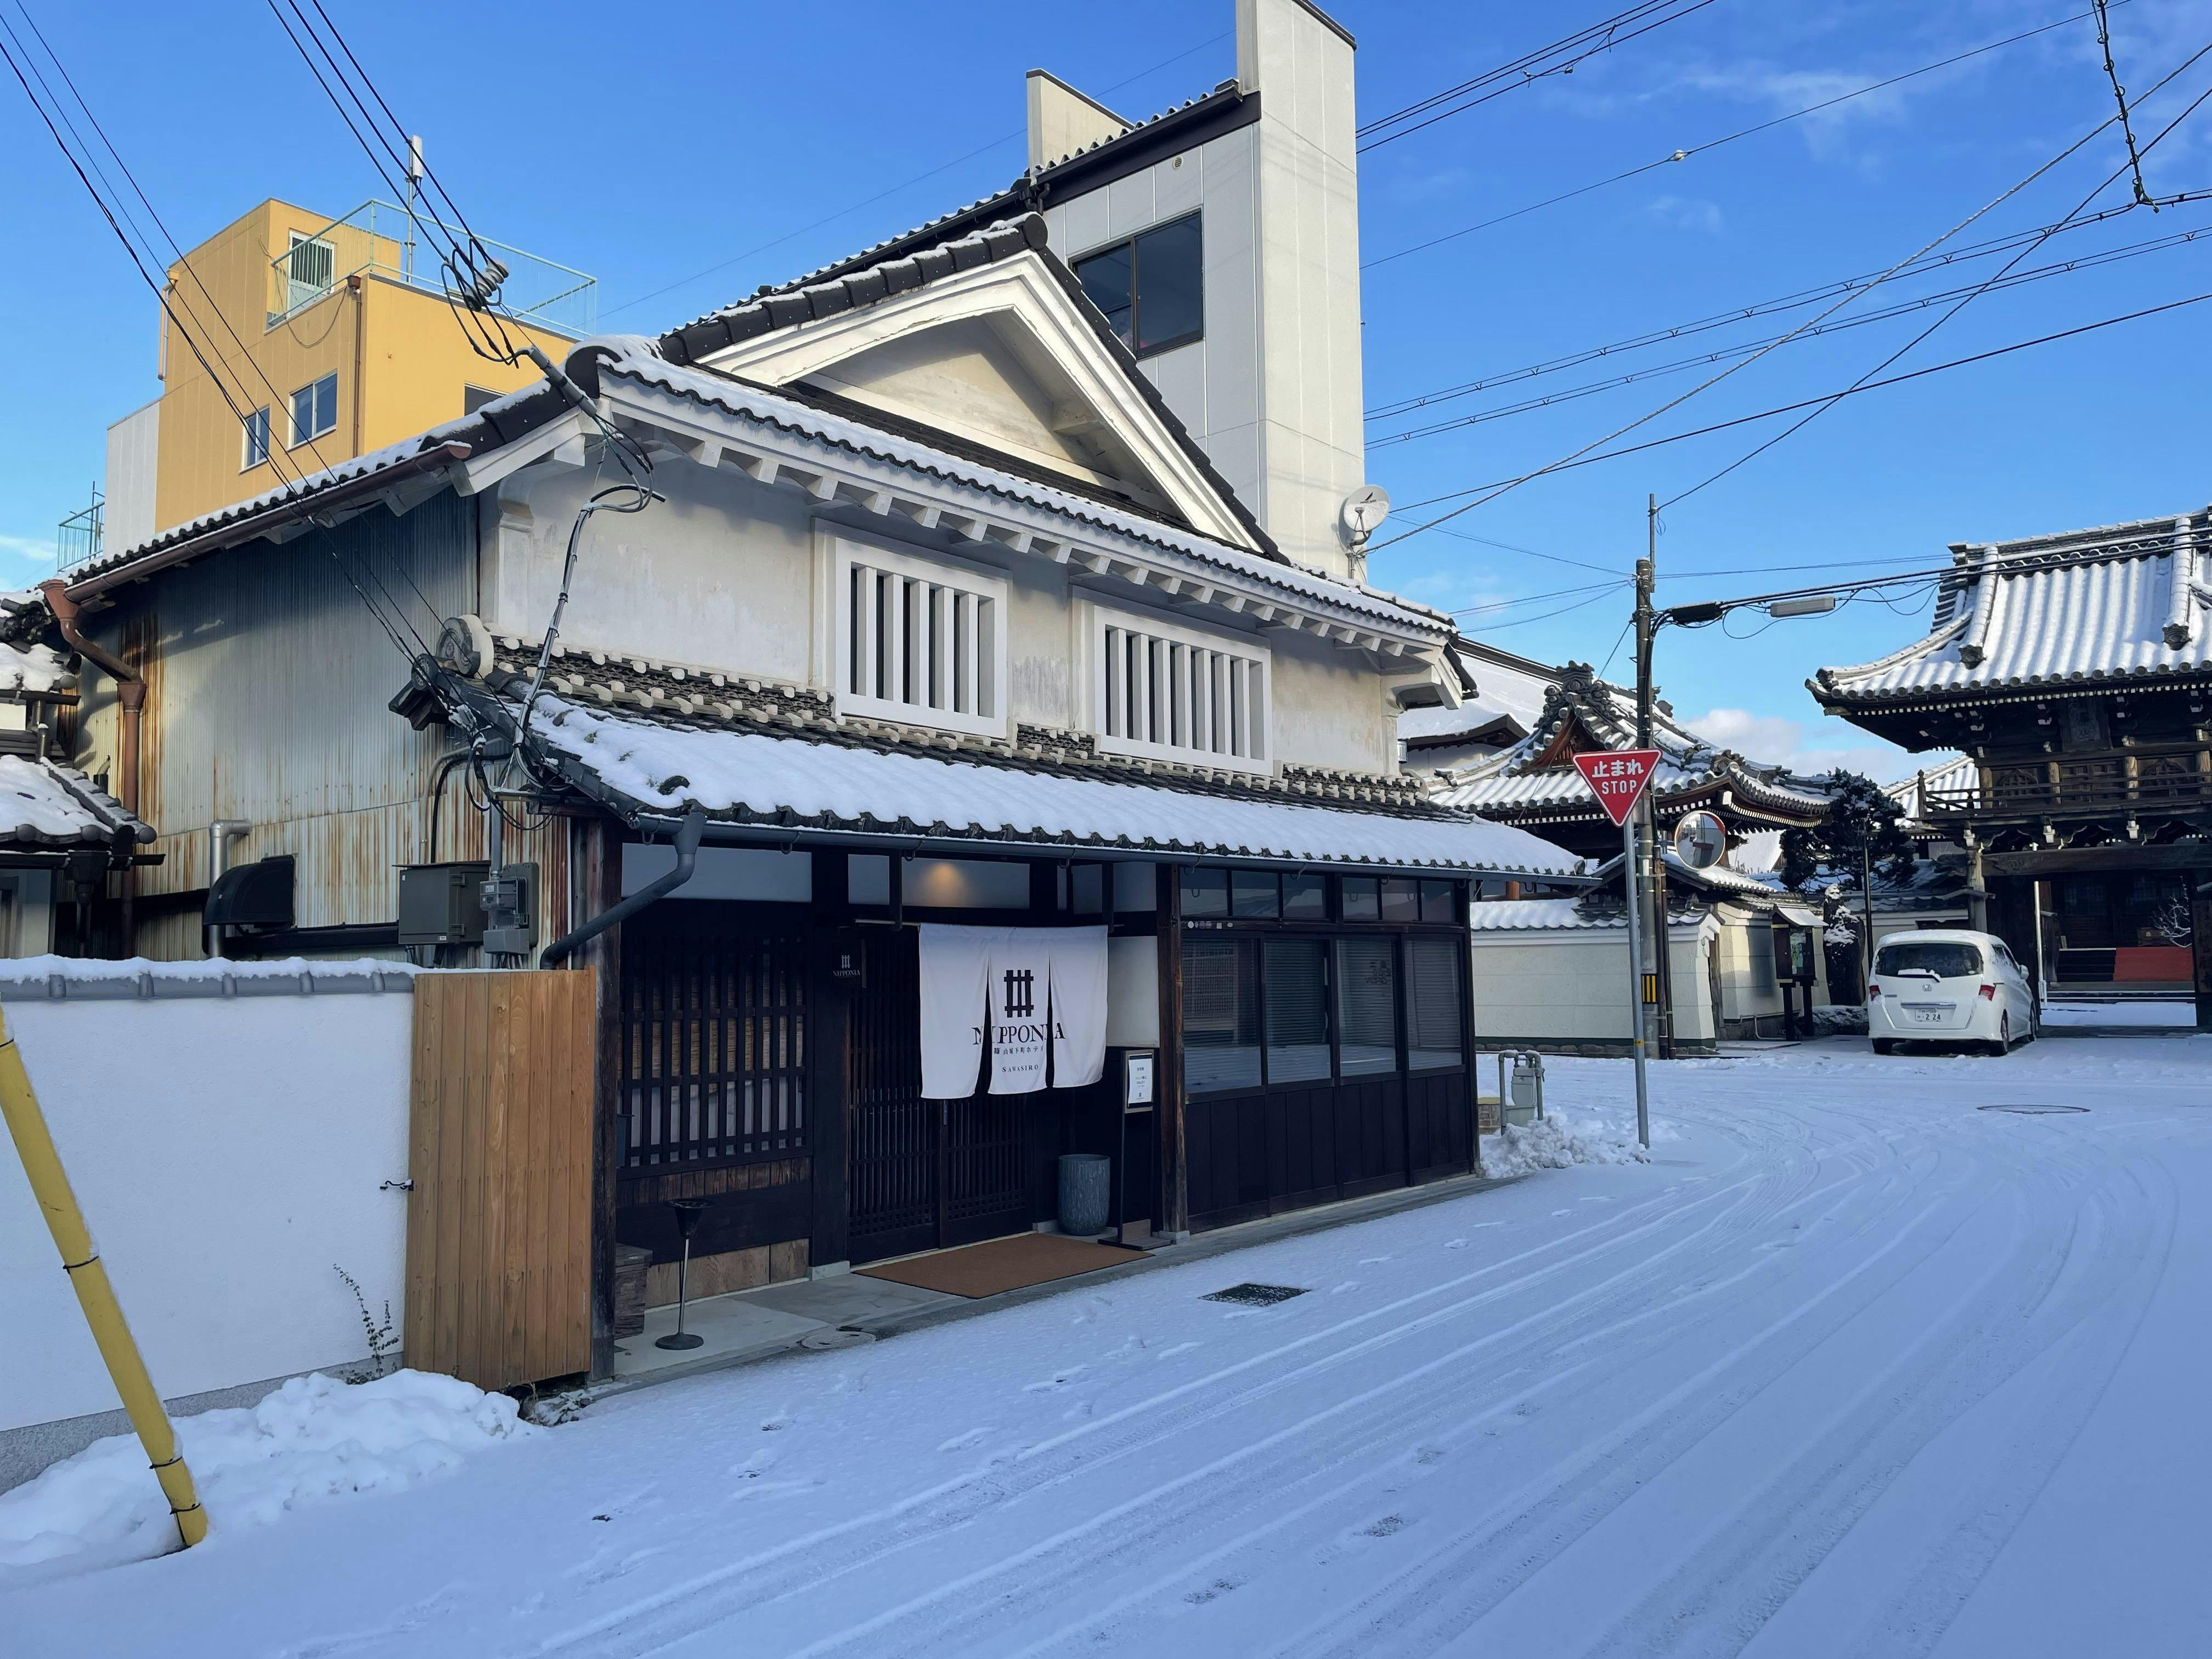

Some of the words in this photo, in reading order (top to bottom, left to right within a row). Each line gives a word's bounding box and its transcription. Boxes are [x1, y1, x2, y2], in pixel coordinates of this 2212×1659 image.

[1592, 759, 1644, 778] 止まれ
[1601, 780, 1637, 795] STOP
